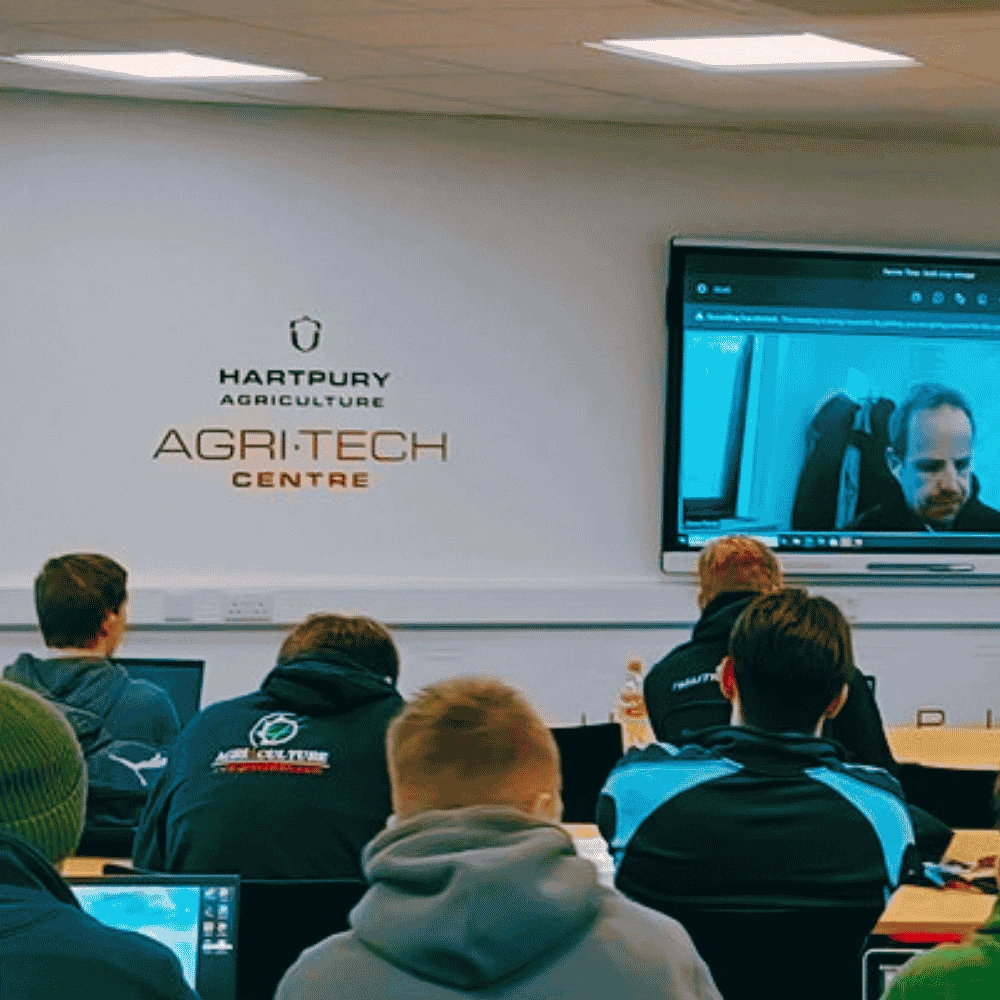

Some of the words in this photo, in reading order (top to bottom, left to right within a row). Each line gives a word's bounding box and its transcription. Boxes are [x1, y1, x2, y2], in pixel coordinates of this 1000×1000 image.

[219, 368, 391, 388] HARTPURY
[219, 394, 386, 408] AGRICULTURE
[231, 471, 369, 488] CENTRE
